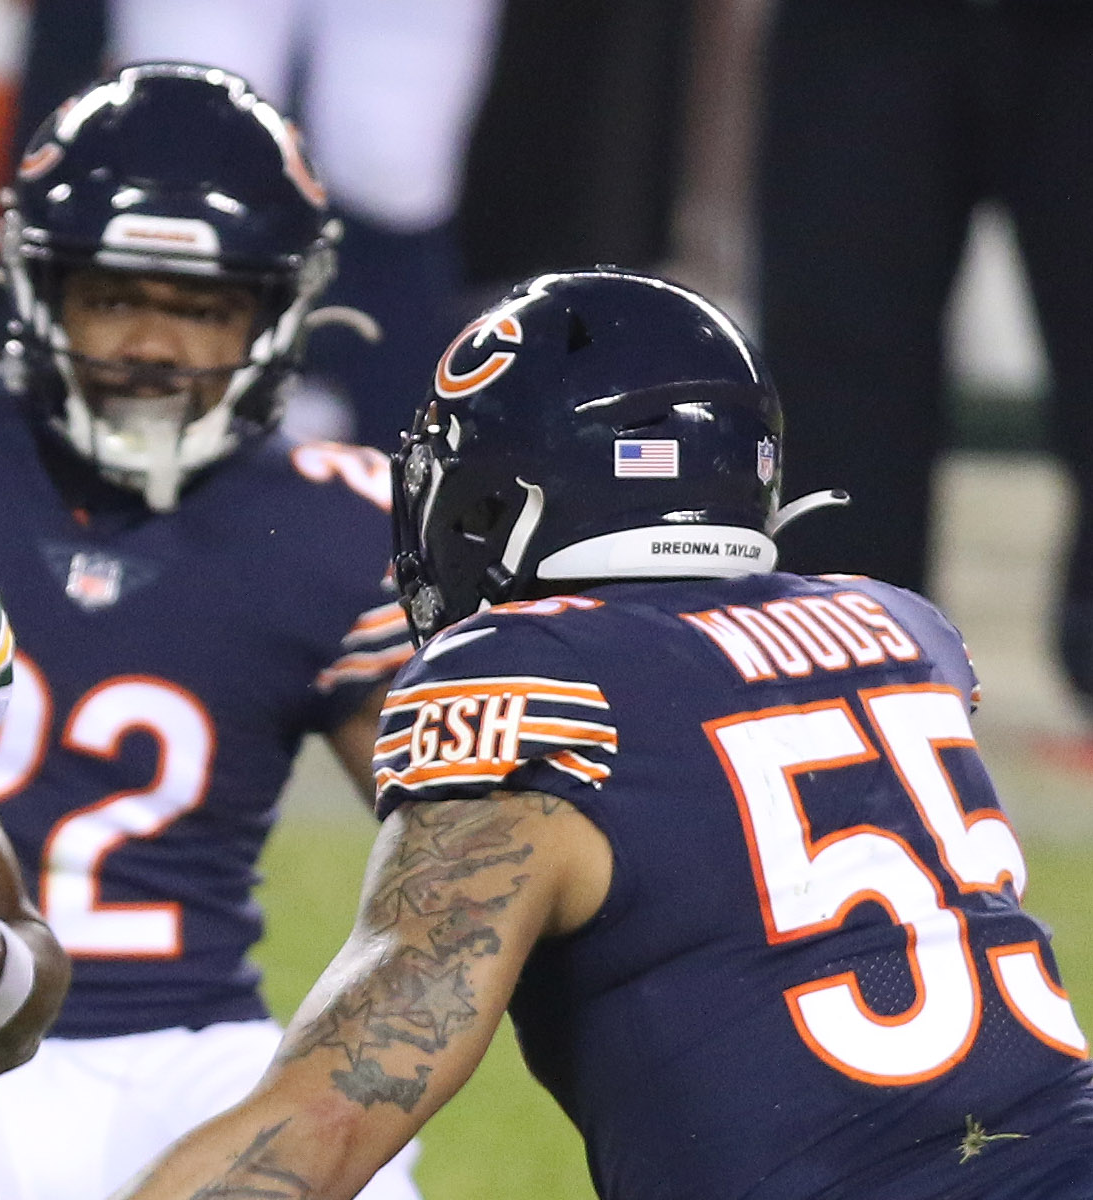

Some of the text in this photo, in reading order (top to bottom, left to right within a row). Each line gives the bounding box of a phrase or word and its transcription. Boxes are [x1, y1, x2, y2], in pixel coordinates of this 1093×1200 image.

[651, 541, 762, 560] BREONNA TAYLOR
[678, 590, 922, 683] WOODS
[410, 692, 528, 768] GSH
[701, 683, 1089, 1087] 55
